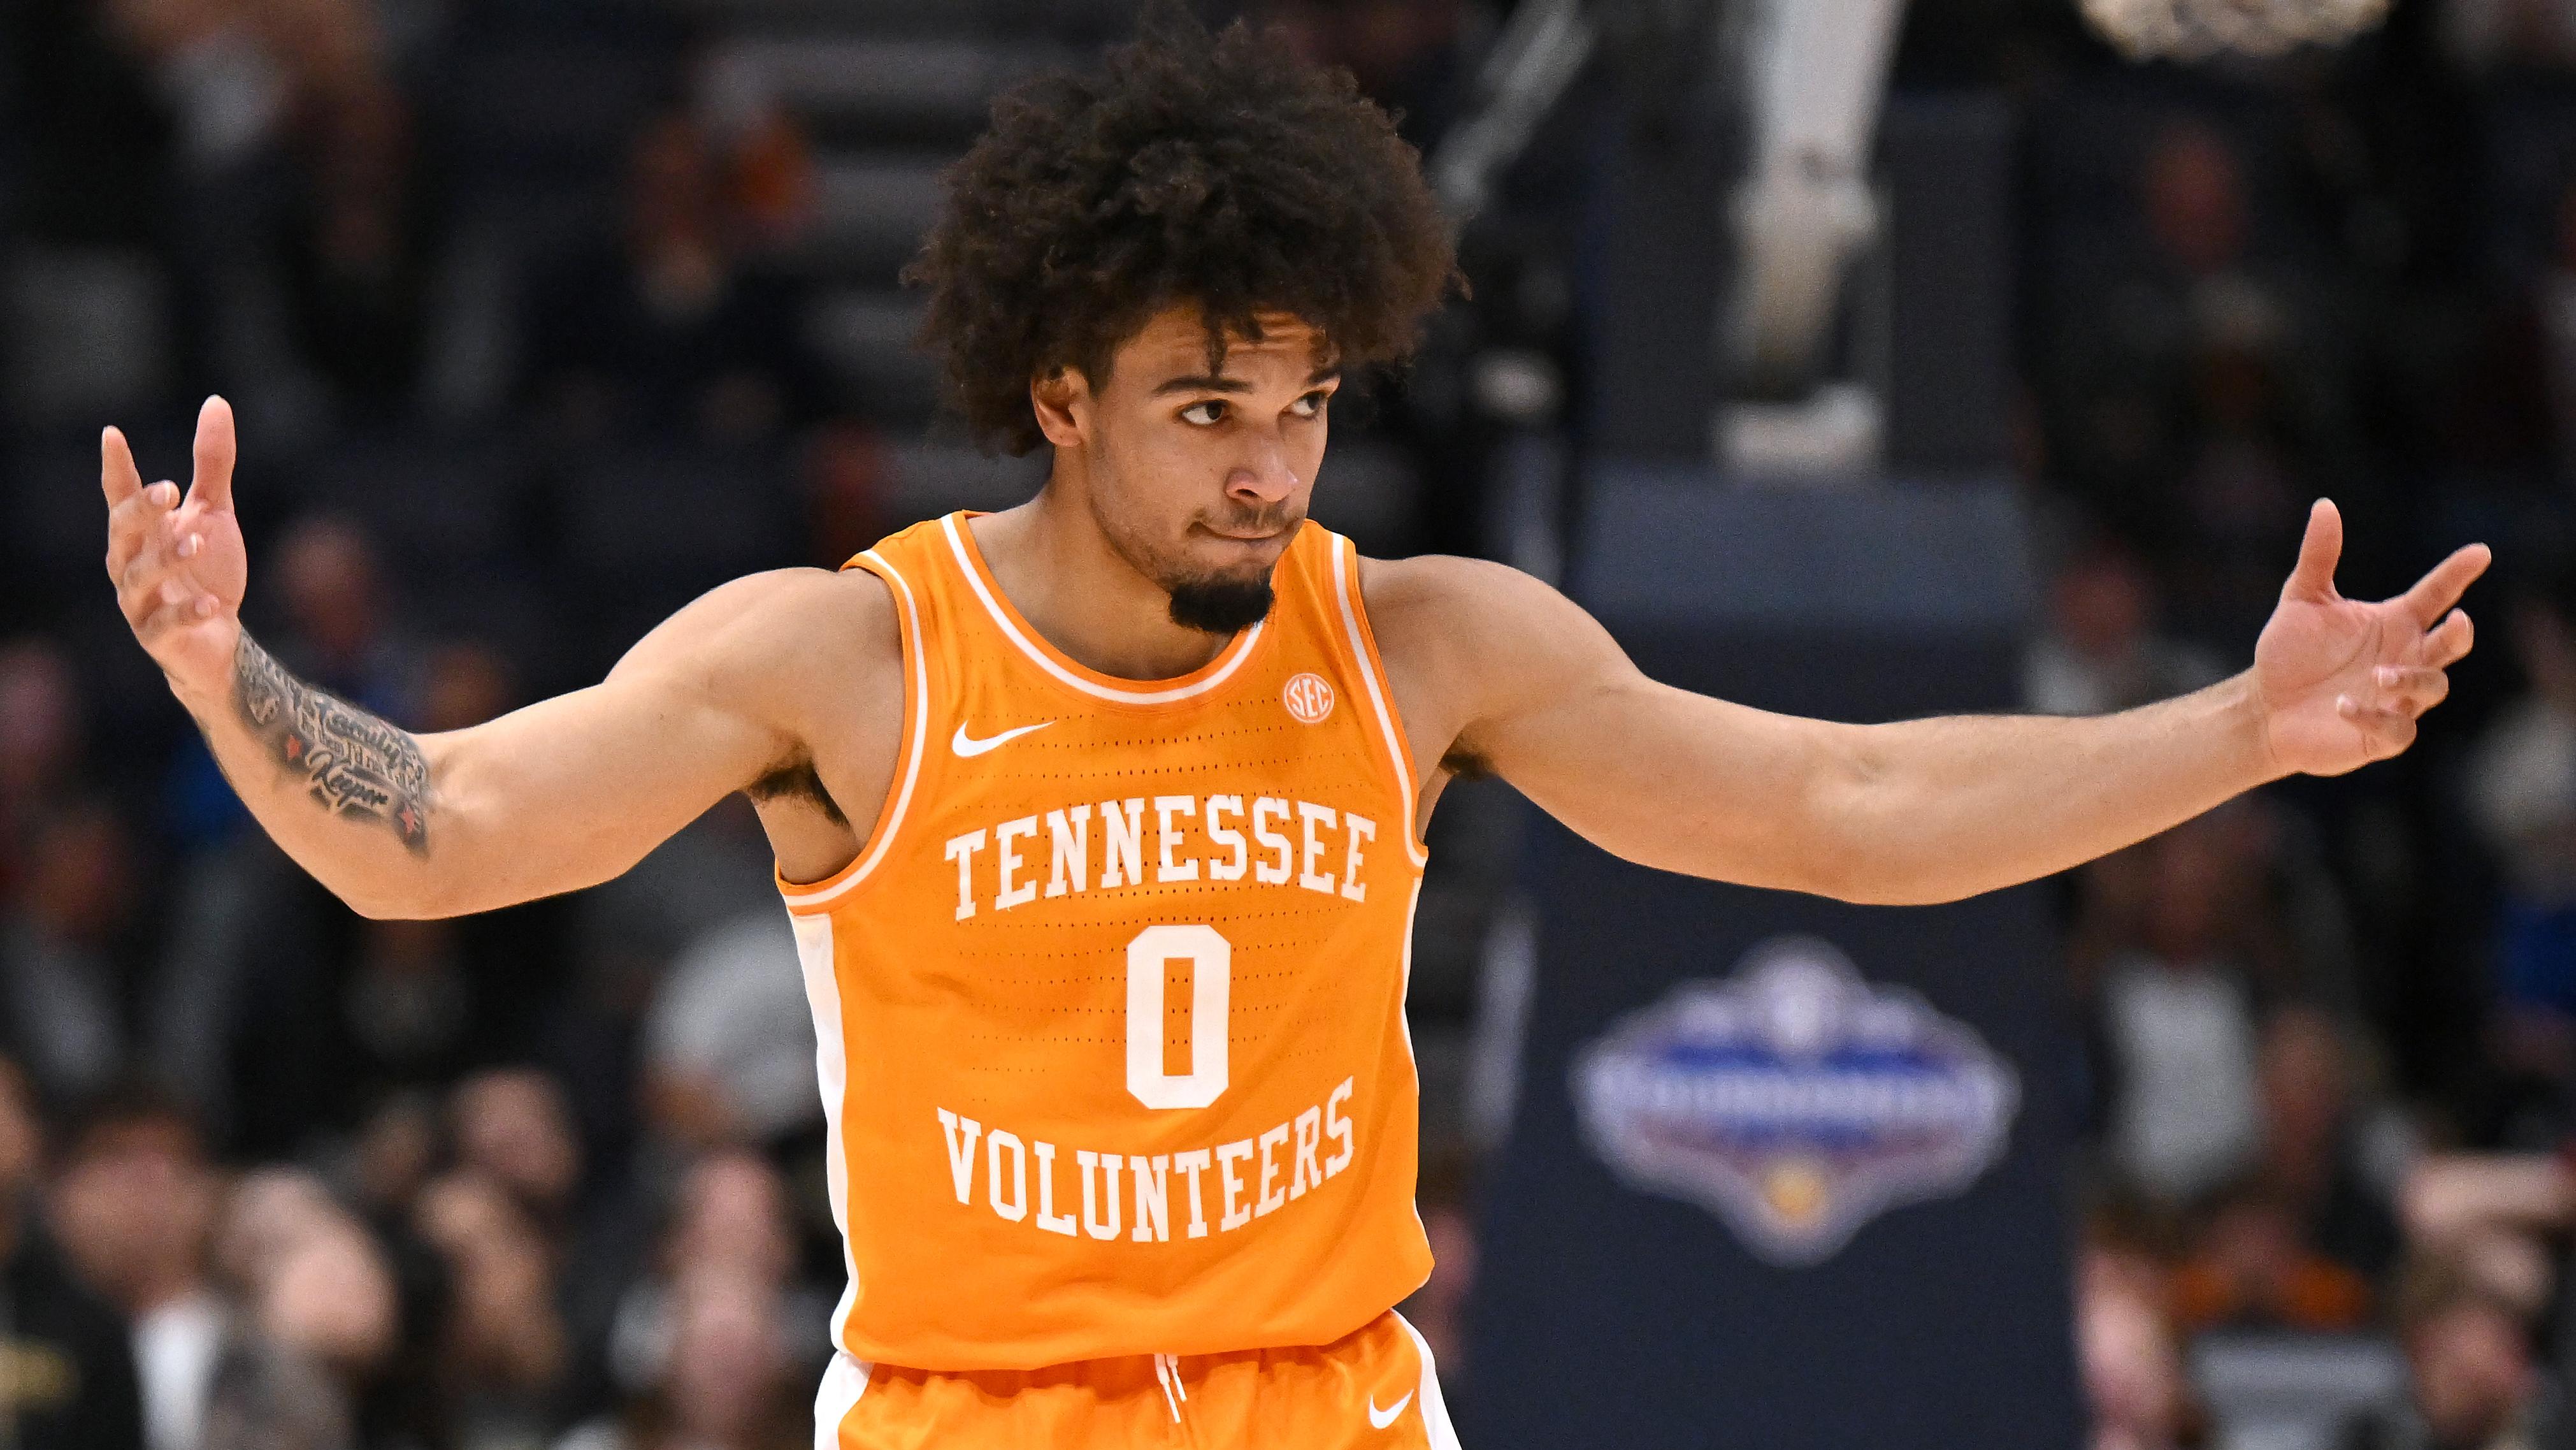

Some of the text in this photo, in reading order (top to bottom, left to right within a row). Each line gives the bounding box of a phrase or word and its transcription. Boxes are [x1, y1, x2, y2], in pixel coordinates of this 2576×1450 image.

[1289, 678, 1328, 717] SEC
[945, 794, 1376, 921] TENNESSEE
[1126, 924, 1231, 1110] 0
[937, 1075, 1355, 1243] VOLUNTEERS
